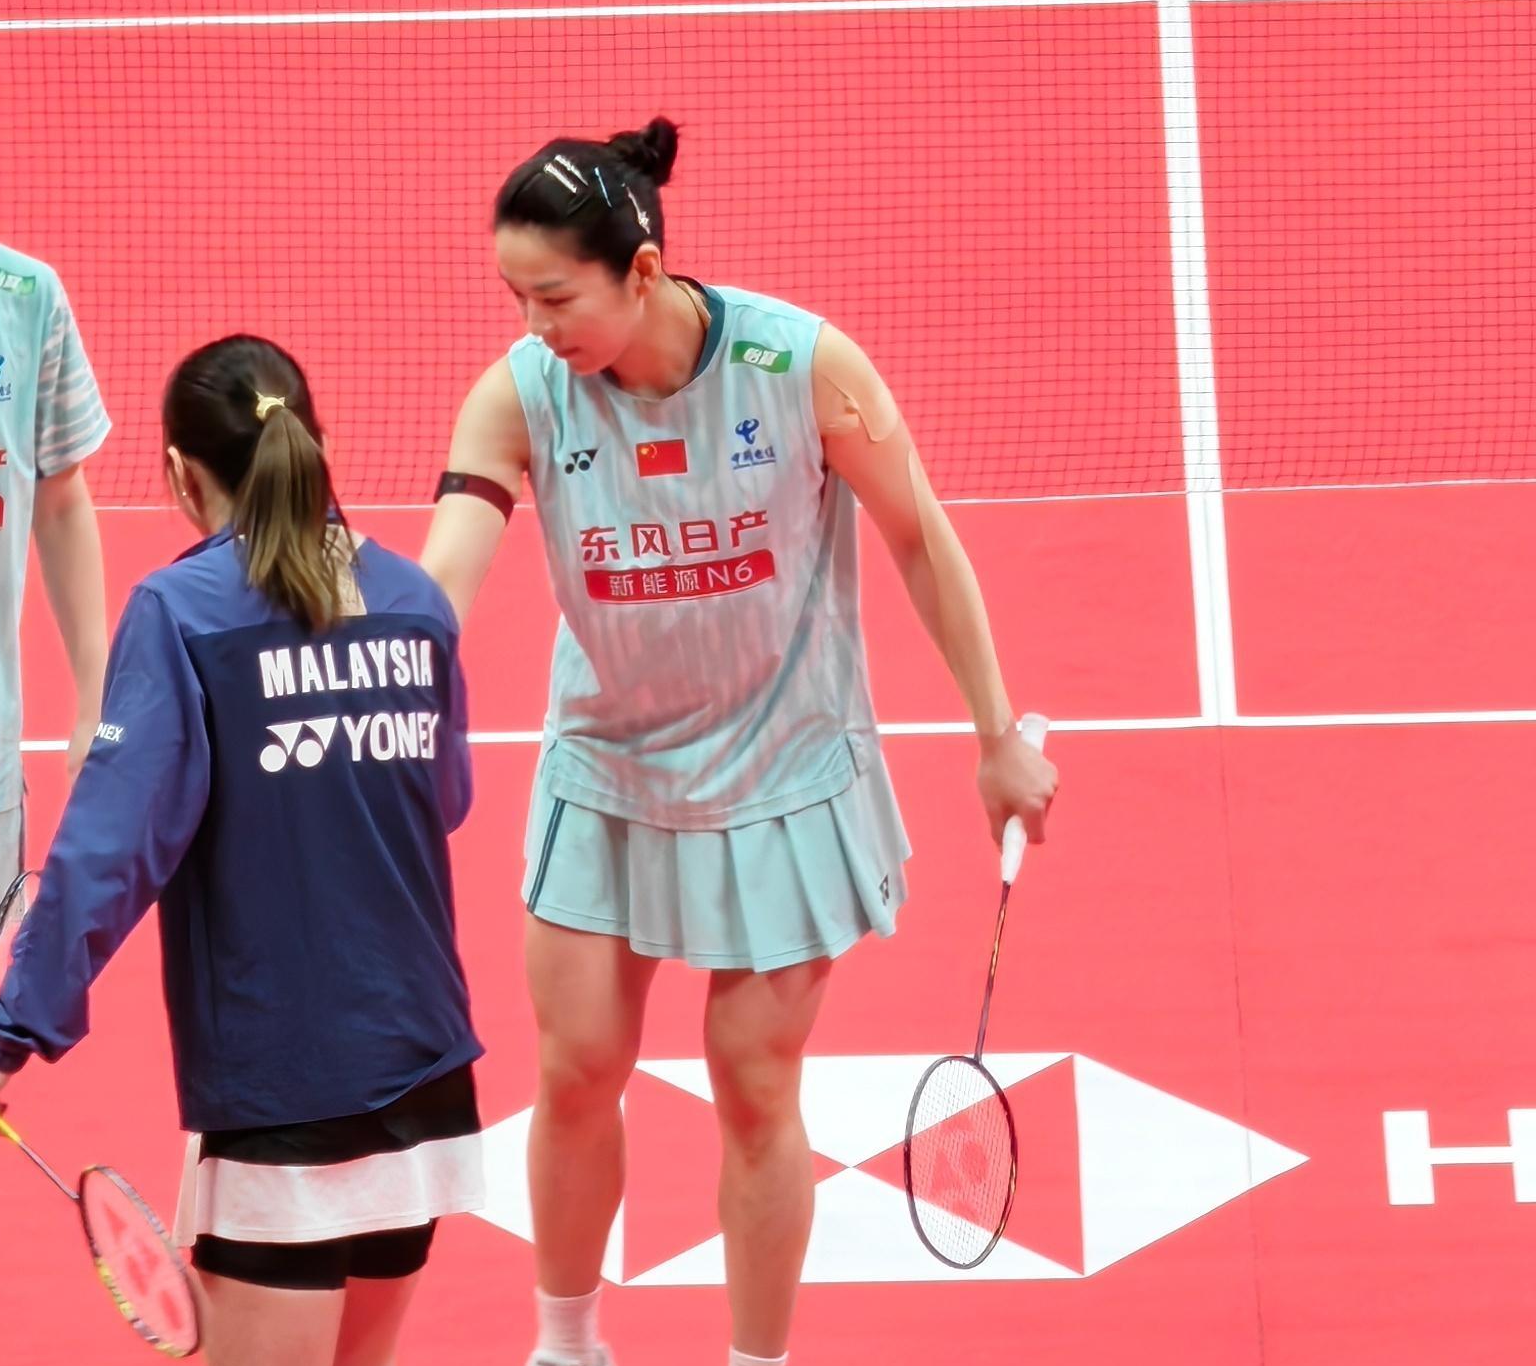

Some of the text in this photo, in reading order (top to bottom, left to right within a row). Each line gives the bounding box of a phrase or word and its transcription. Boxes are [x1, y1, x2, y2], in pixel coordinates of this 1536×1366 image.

[579, 510, 769, 562] 东风日产
[609, 564, 755, 597] 新能源N6
[258, 639, 434, 698] MALAYSIA
